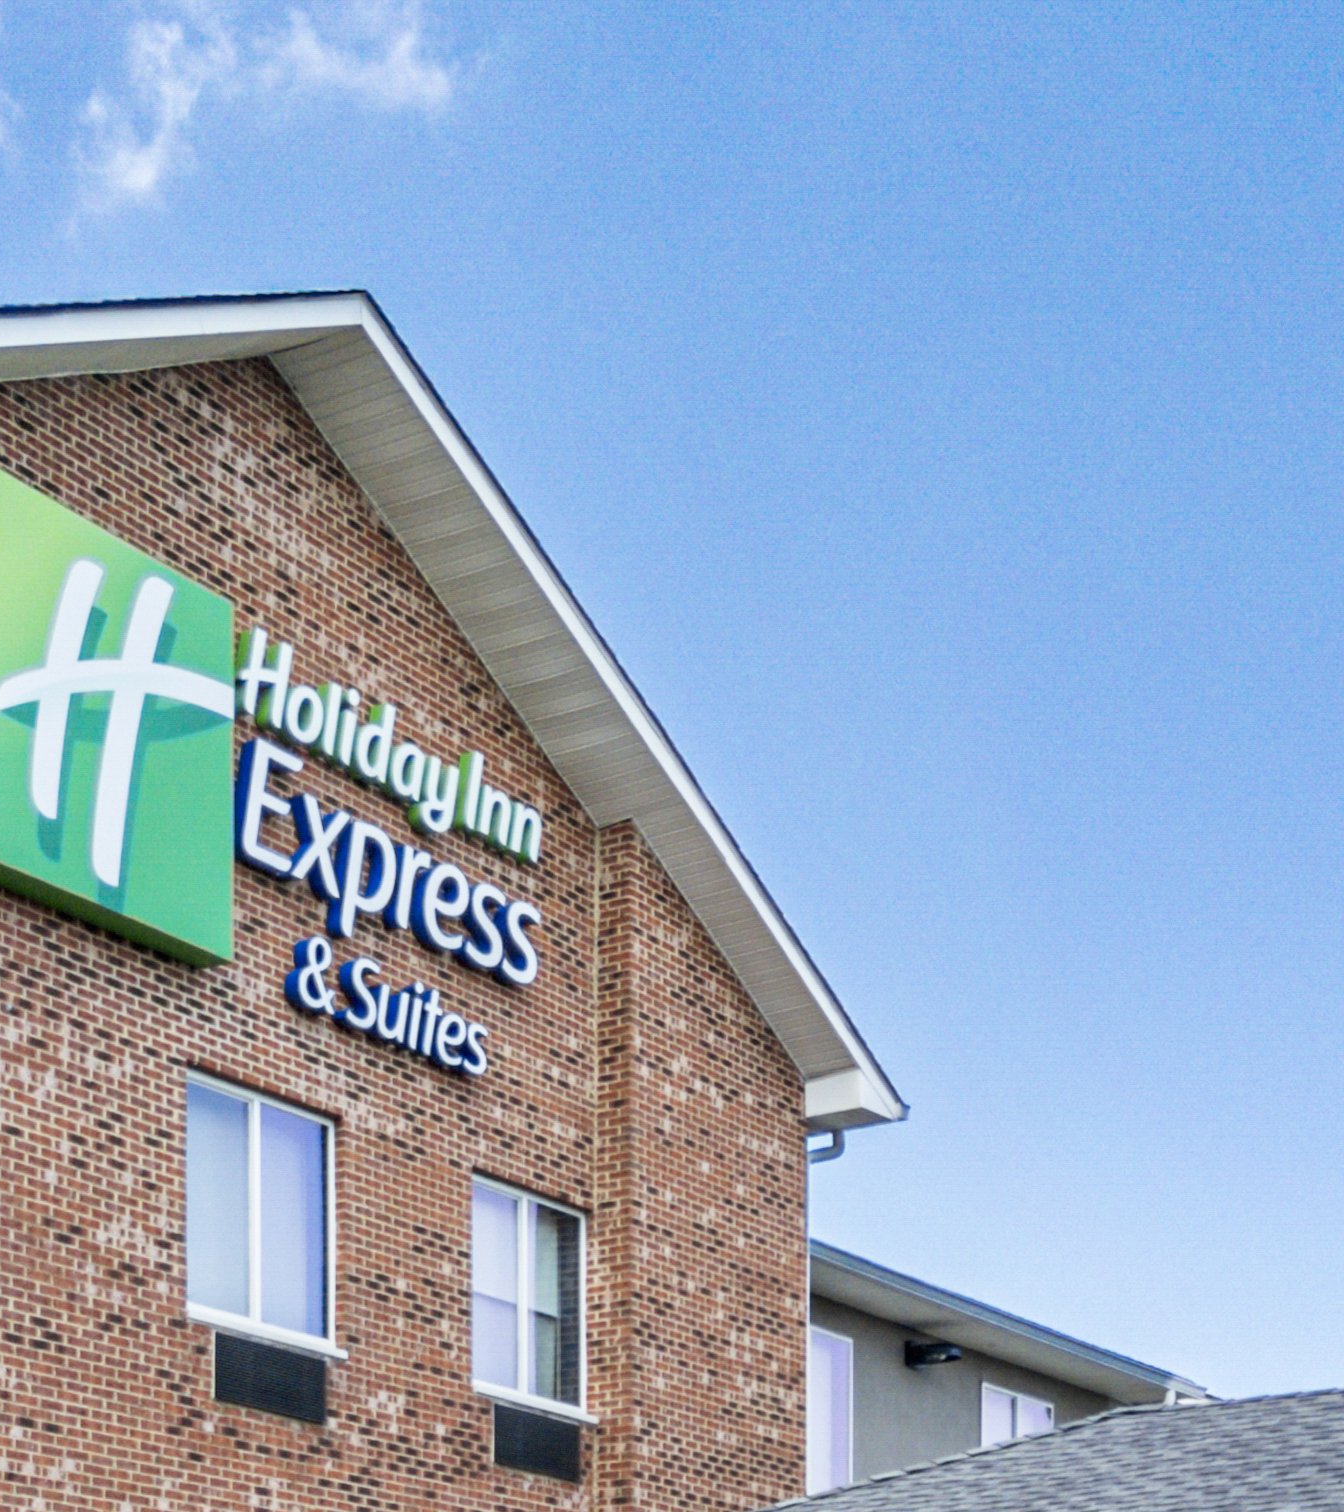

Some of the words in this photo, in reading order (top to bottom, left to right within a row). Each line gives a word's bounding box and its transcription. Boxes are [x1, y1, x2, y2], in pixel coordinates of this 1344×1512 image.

[237, 626, 460, 834] Holiday
[462, 750, 543, 865] Inn
[238, 737, 543, 986] Express
[286, 935, 336, 1017] &
[342, 956, 489, 1076] Suites
